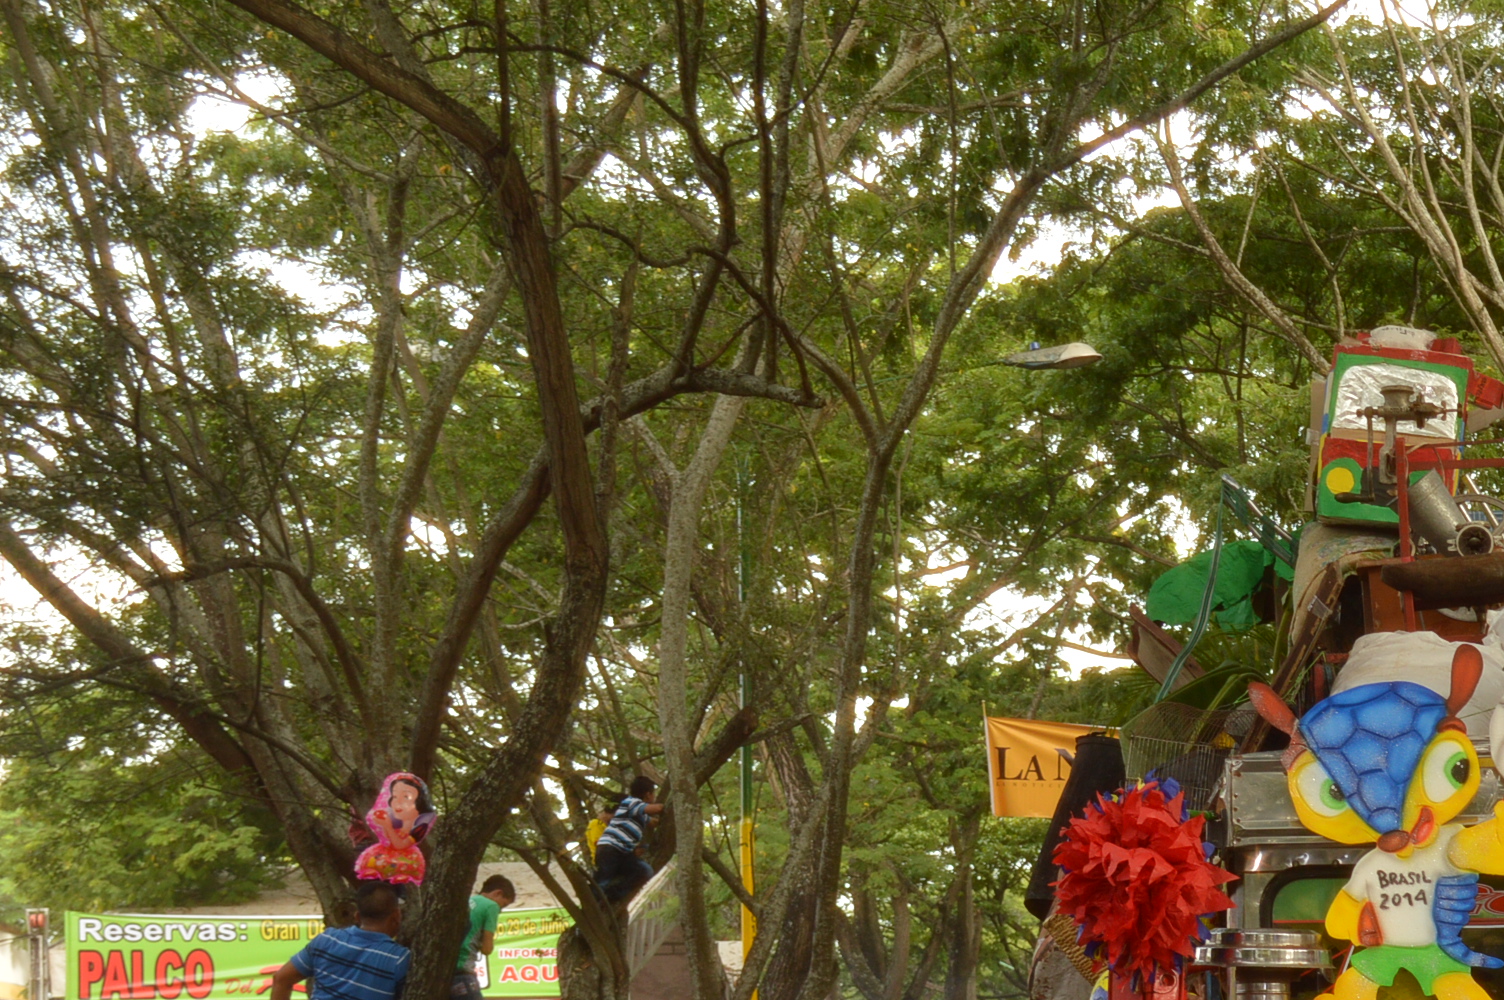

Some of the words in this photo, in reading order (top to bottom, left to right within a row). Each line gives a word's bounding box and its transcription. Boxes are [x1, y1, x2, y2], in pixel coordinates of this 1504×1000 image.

[994, 746, 1046, 781] LA
[1376, 869, 1432, 889] BRASIL
[1379, 889, 1428, 910] 2014
[78, 918, 249, 942] Reservas:
[260, 920, 300, 941] Gran
[507, 919, 521, 935] 29
[523, 918, 536, 935] de
[499, 949, 558, 958] INFORME
[78, 949, 215, 1000] PALCO
[500, 965, 559, 982] AQU
[224, 977, 254, 995] Del
